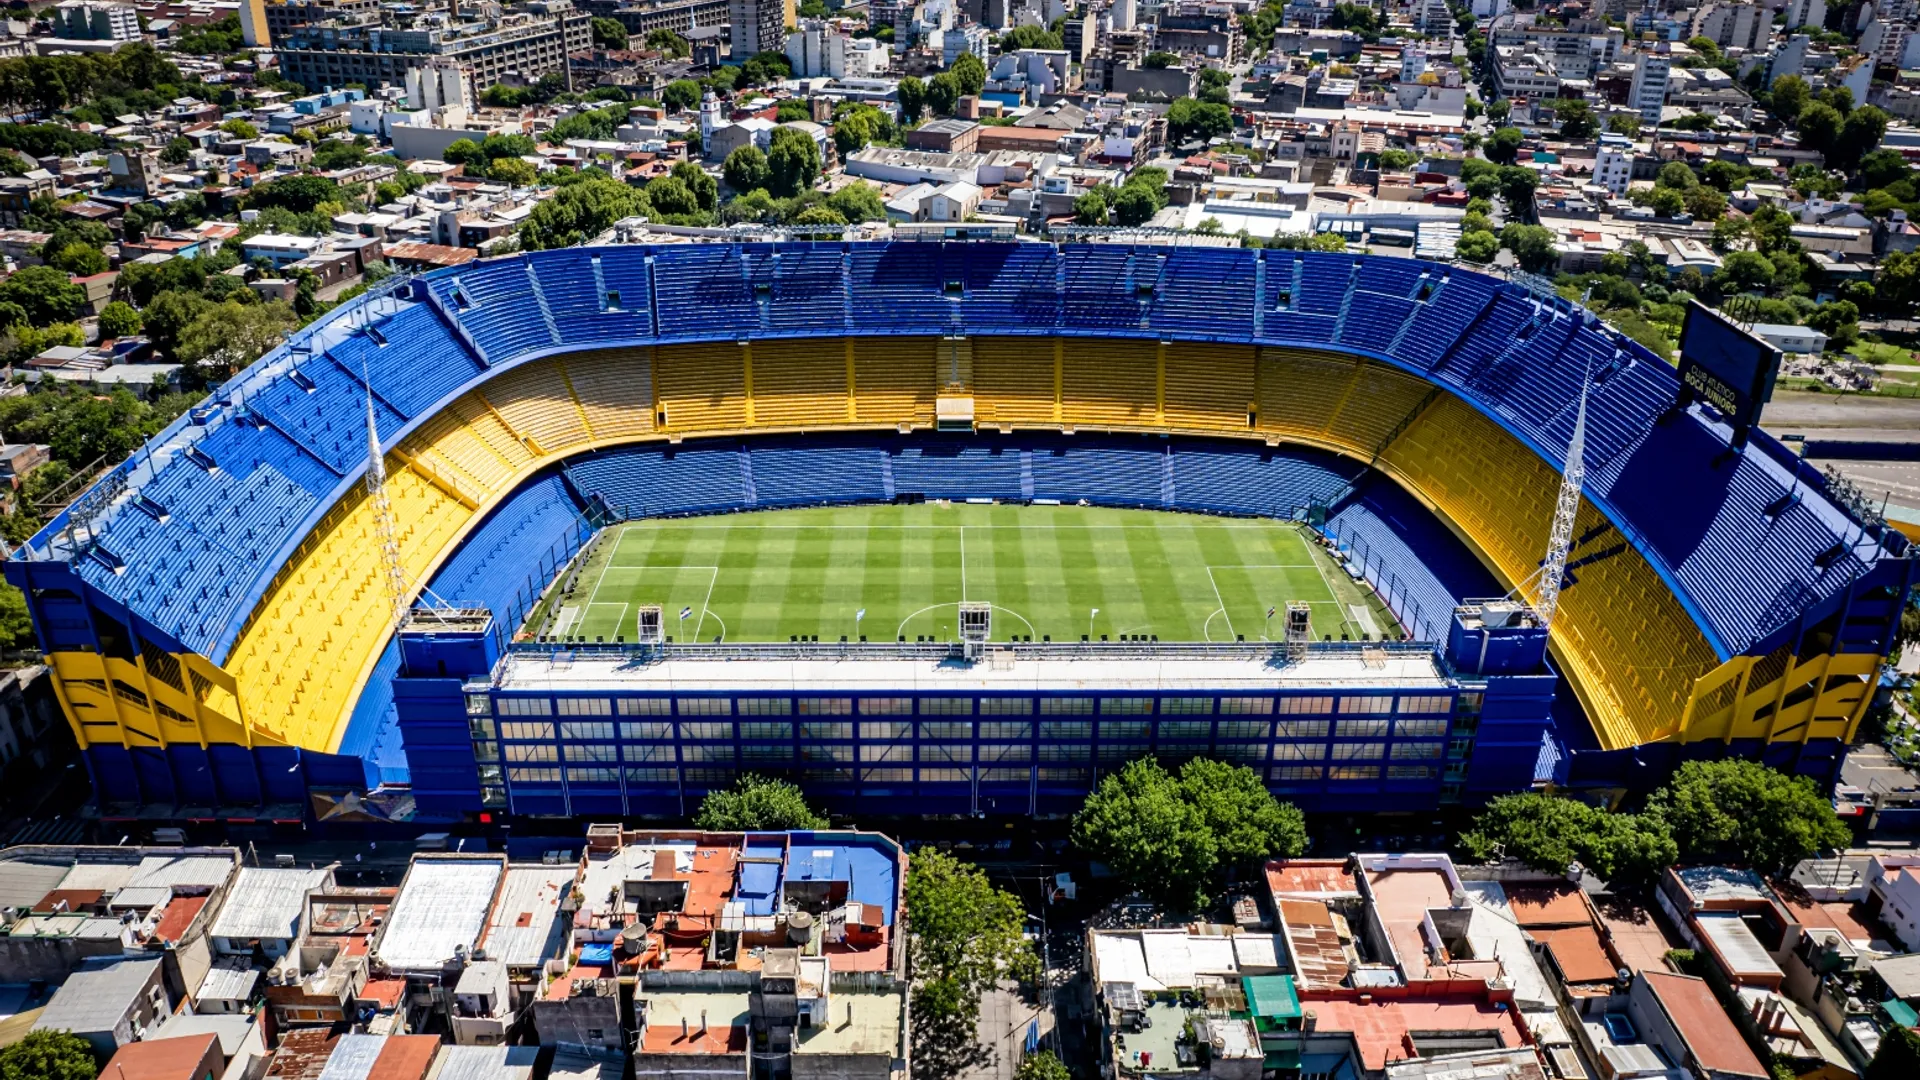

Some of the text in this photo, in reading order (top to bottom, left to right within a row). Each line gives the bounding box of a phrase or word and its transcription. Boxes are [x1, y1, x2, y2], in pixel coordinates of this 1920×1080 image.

[1691, 364, 1707, 382] CLUB
[1685, 371, 1737, 415] BOCA JUNIORS
